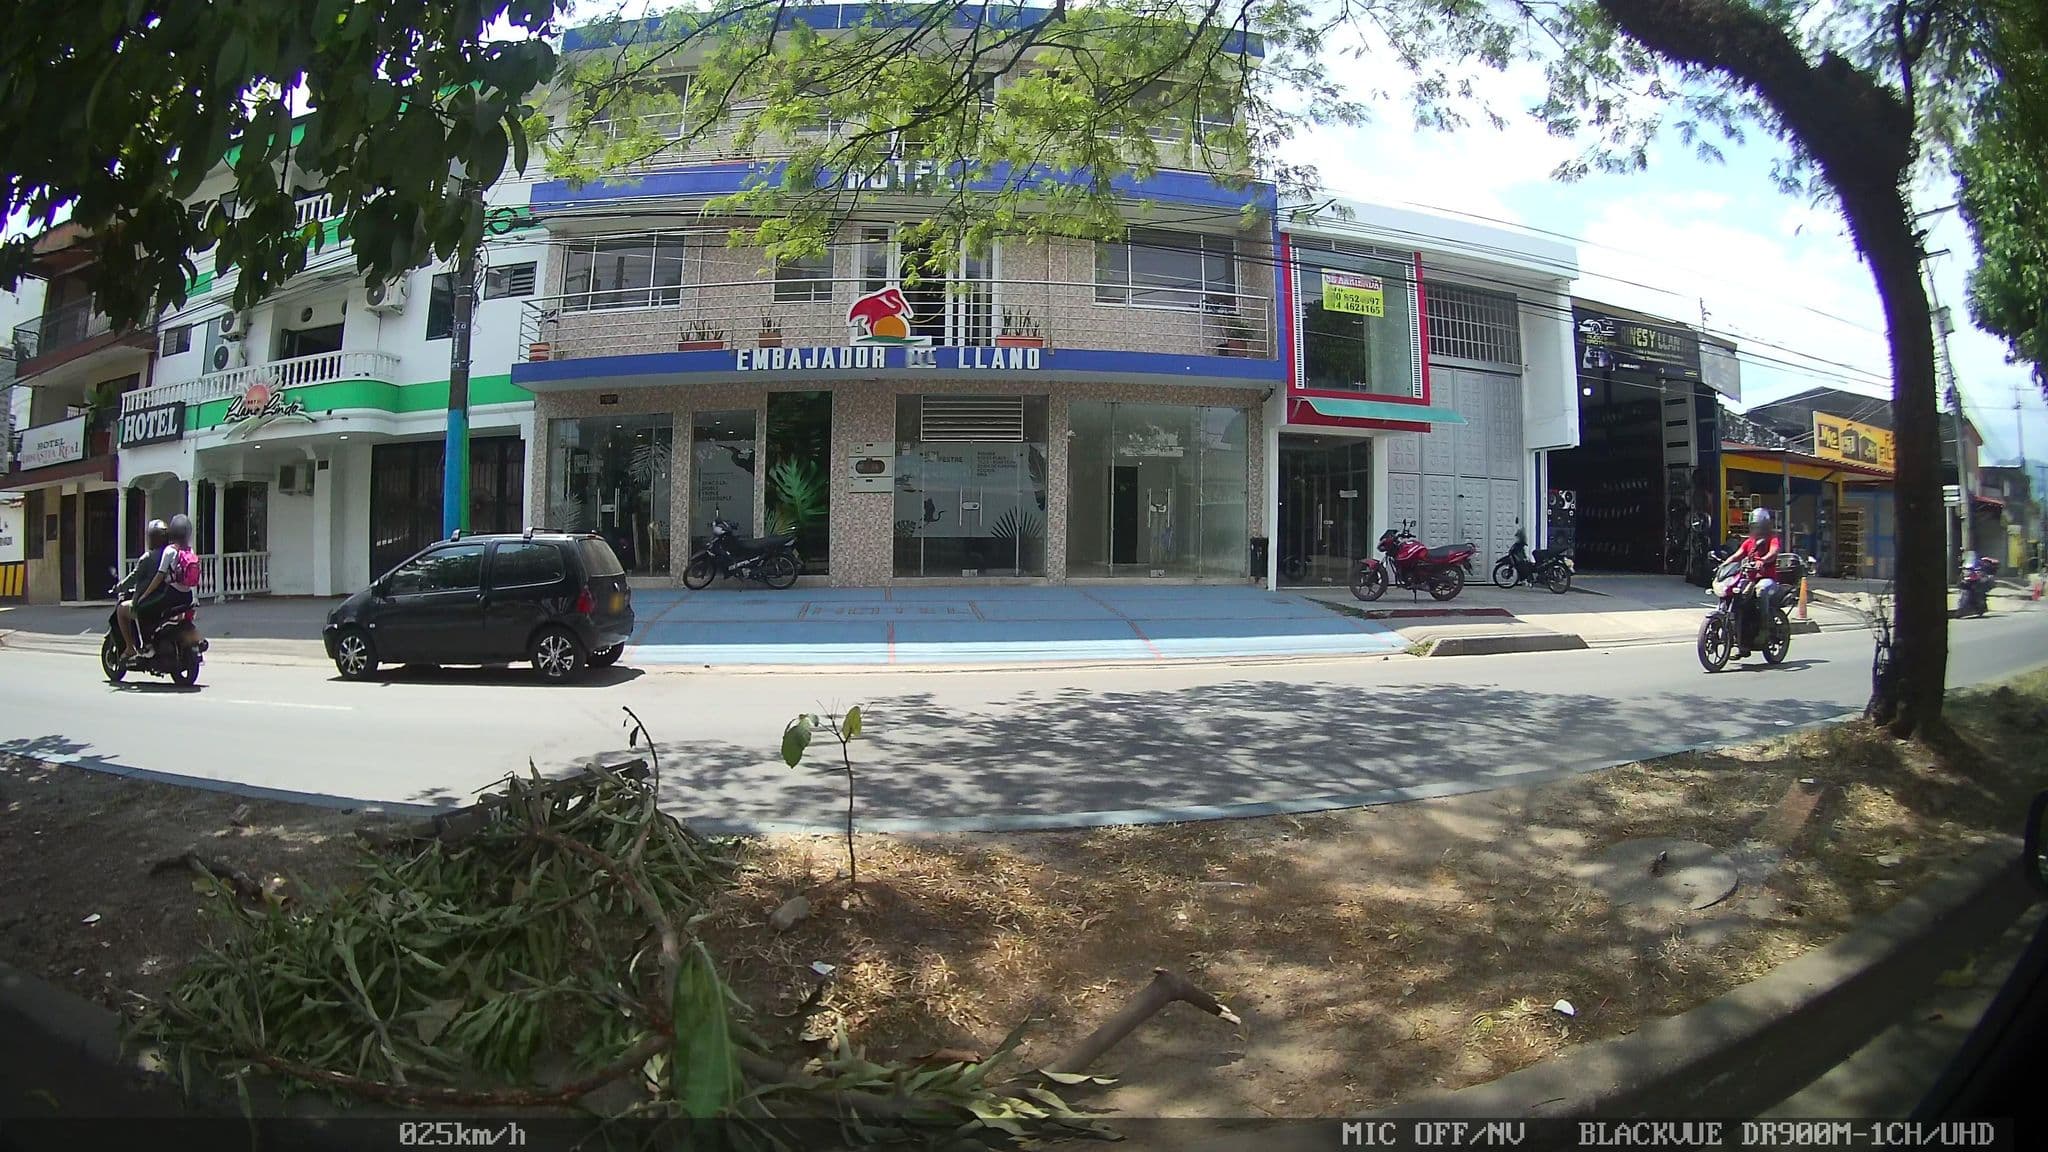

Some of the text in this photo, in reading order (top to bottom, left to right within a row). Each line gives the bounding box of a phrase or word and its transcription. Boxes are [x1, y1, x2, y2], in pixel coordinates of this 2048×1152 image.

[1649, 330, 1656, 348] Y
[736, 347, 886, 371] EMBAJADOR
[958, 347, 1040, 370] LLANO
[123, 408, 178, 443] HOTEL
[37, 437, 65, 450] HOTEL
